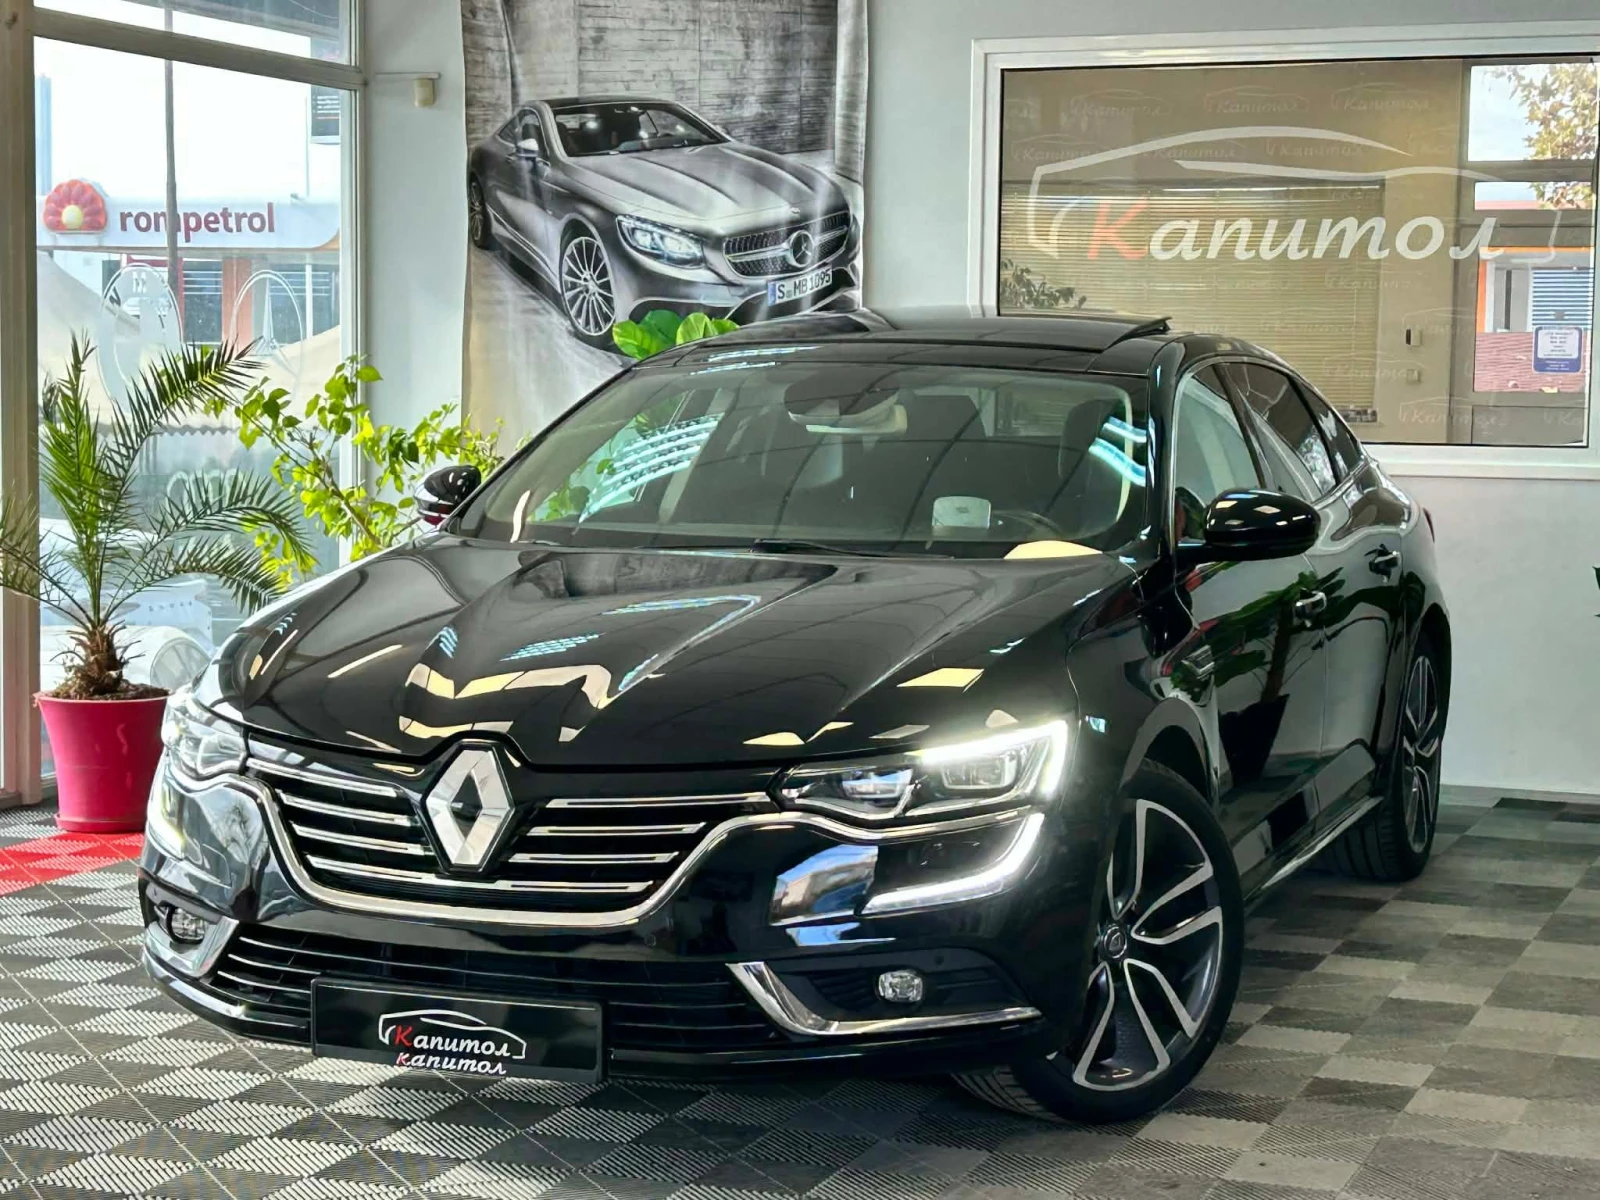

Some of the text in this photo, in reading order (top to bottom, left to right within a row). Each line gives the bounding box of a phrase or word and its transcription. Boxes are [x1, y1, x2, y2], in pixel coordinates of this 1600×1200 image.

[119, 202, 275, 243] rompetrol
[1087, 194, 1505, 261] Капитол
[777, 268, 831, 299] S MB 1095
[394, 1024, 511, 1057] Капитол
